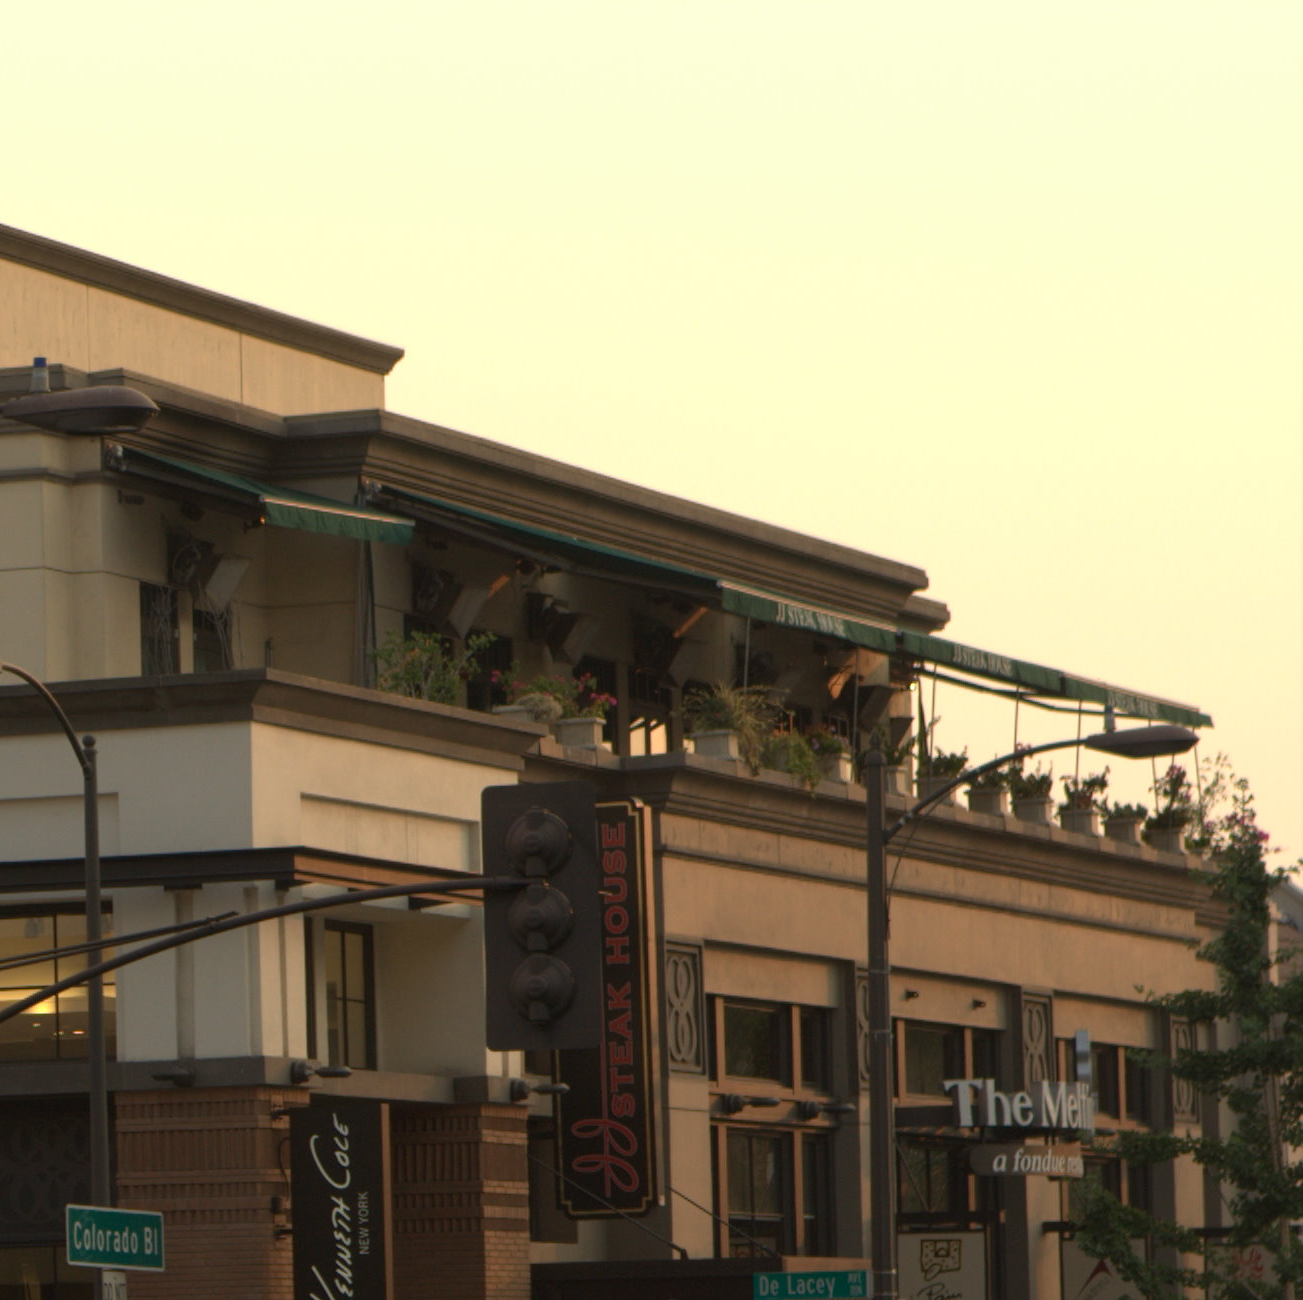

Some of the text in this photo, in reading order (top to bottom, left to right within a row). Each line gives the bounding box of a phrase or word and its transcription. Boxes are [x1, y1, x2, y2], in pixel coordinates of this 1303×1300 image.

[601, 822, 630, 965] HOUSE
[607, 982, 636, 1119] STEAK
[943, 1078, 1035, 1127] The
[993, 1154, 1007, 1173] a
[1010, 1148, 1066, 1173] fondue
[73, 1220, 139, 1254] Colorado
[356, 1191, 371, 1255] NEW YORK
[759, 1273, 836, 1299] De Lacey
